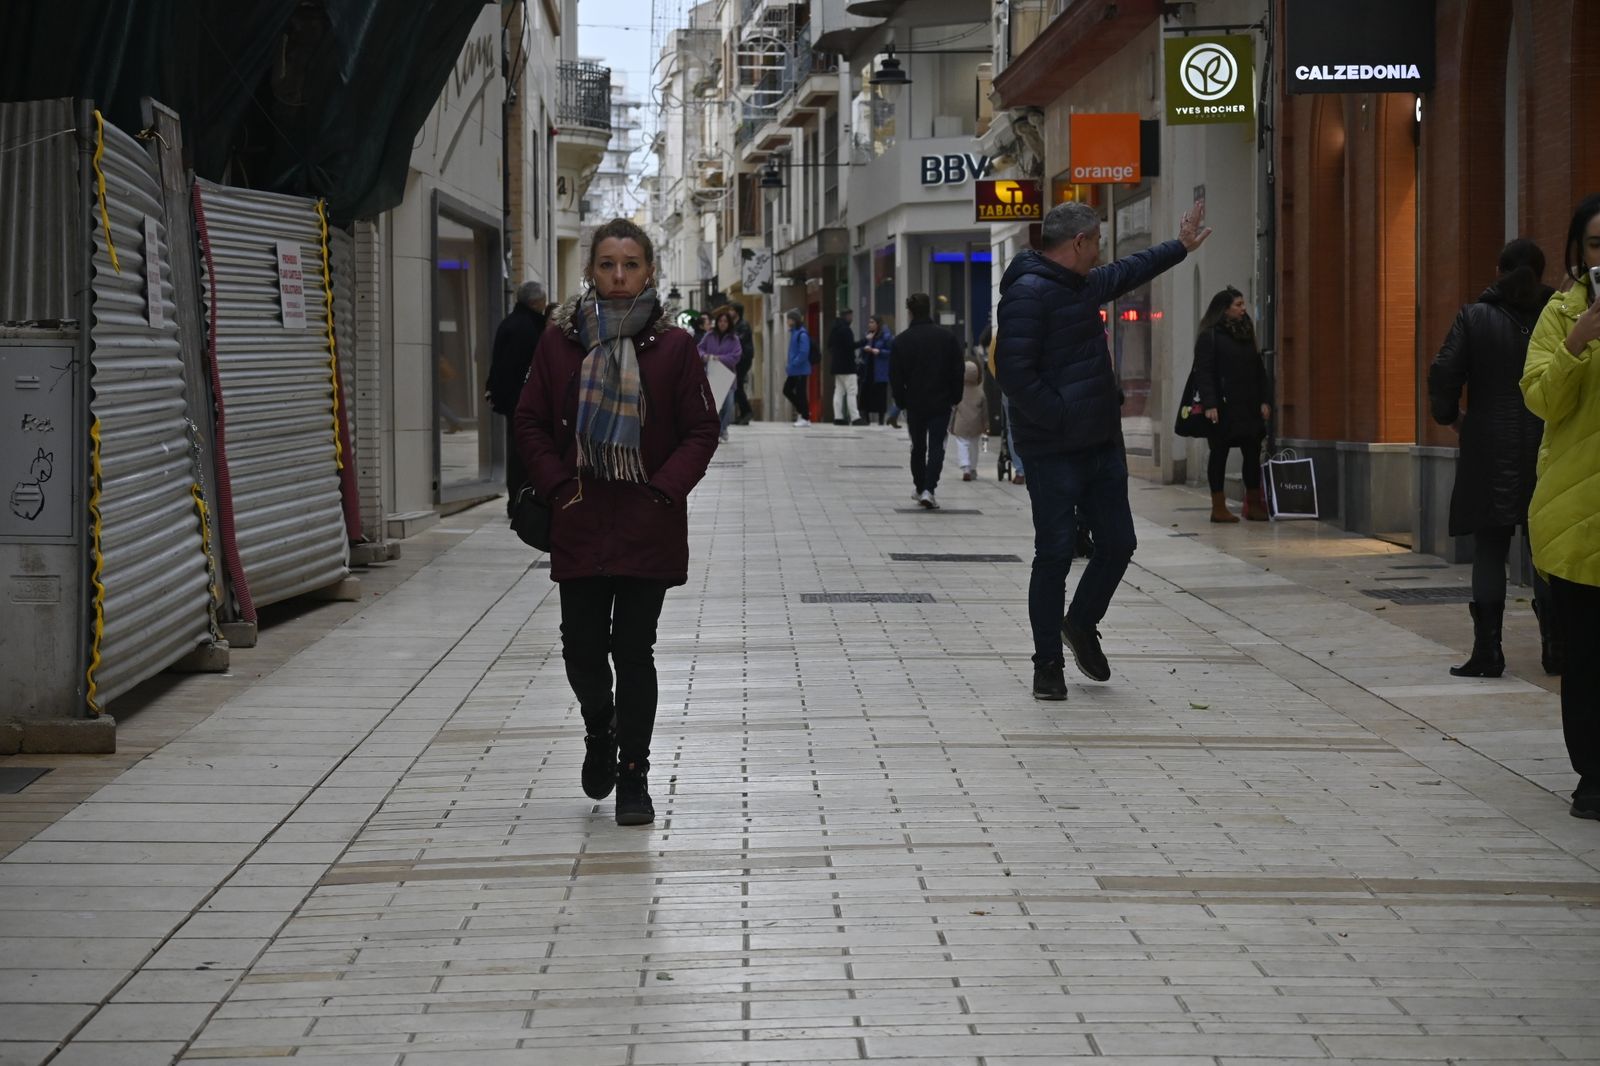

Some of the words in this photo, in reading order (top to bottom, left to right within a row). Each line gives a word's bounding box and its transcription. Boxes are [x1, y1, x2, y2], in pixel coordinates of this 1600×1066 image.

[1295, 64, 1421, 80] CALZEDONIA
[1175, 106, 1201, 115] YVES
[1203, 104, 1246, 114] ROCHER
[1074, 166, 1133, 181] orange
[979, 204, 1040, 216] TABACOS
